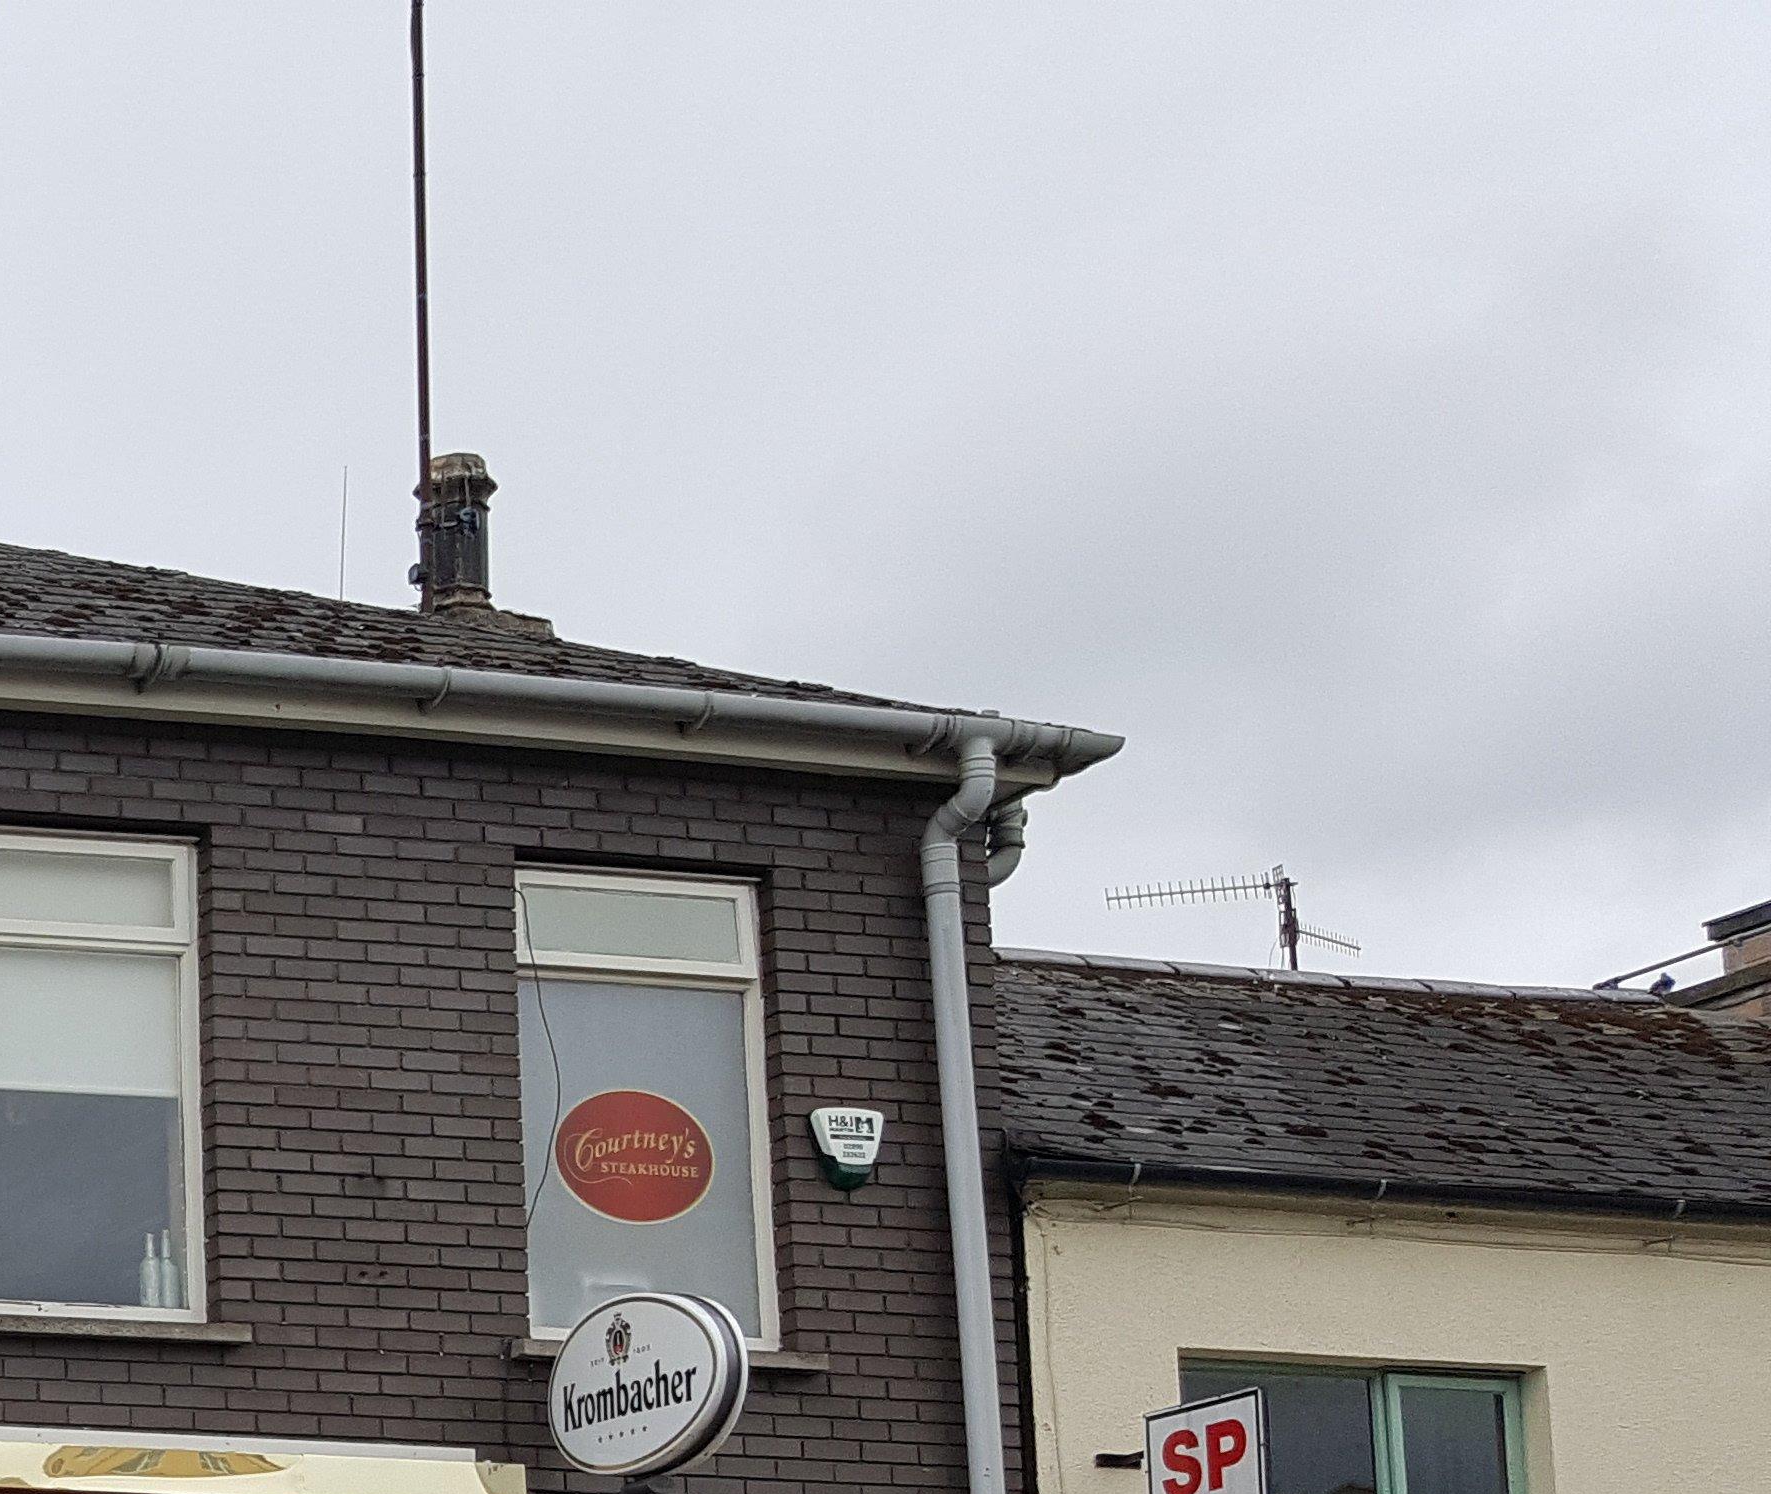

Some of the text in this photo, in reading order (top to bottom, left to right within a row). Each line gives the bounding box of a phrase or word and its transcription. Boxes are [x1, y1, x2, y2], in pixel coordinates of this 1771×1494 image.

[564, 1127, 697, 1180] Courtney's
[600, 1162, 699, 1178] STEAKHOUSE
[563, 1359, 697, 1432] Krombacher
